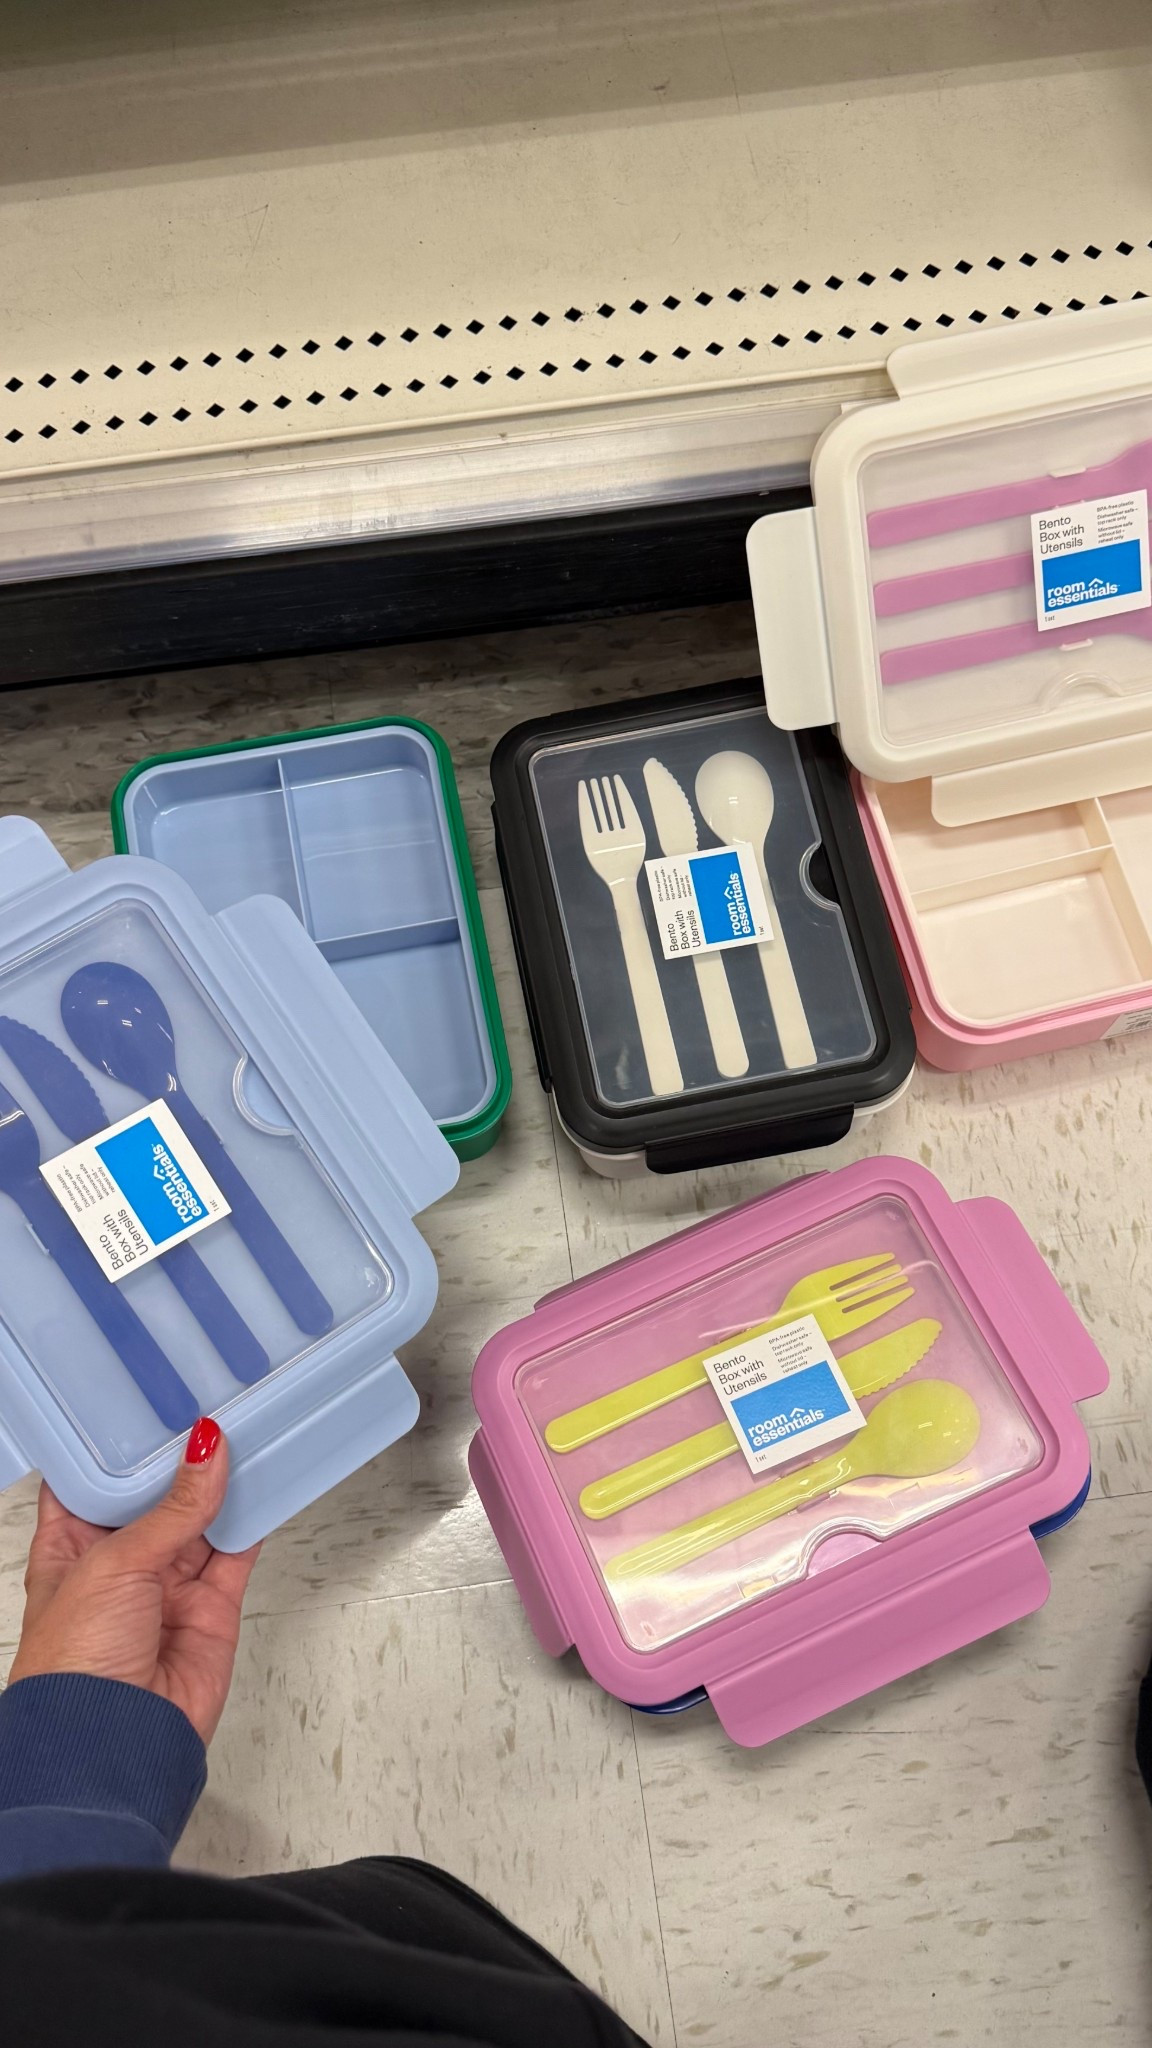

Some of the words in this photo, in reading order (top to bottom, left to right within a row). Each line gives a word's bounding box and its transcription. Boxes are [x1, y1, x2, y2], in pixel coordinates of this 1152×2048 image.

[1039, 516, 1072, 531] Bento
[1039, 529, 1061, 543] Box
[1062, 524, 1085, 537] with
[1040, 537, 1083, 555] Utensils
[1047, 581, 1085, 599] room
[675, 910, 686, 930] with
[687, 909, 701, 948] Utensils
[726, 901, 742, 936] room
[667, 923, 680, 952] Bento
[681, 930, 690, 950] Box
[162, 1181, 193, 1224] room
[103, 1214, 122, 1237] with
[117, 1209, 149, 1256] Utensils
[99, 1234, 125, 1270] Bento
[118, 1237, 137, 1264] Box
[713, 1354, 747, 1374] Bento
[718, 1371, 741, 1385] Box
[742, 1359, 765, 1374] with
[723, 1371, 768, 1396] Utensils
[748, 1413, 788, 1438] room
